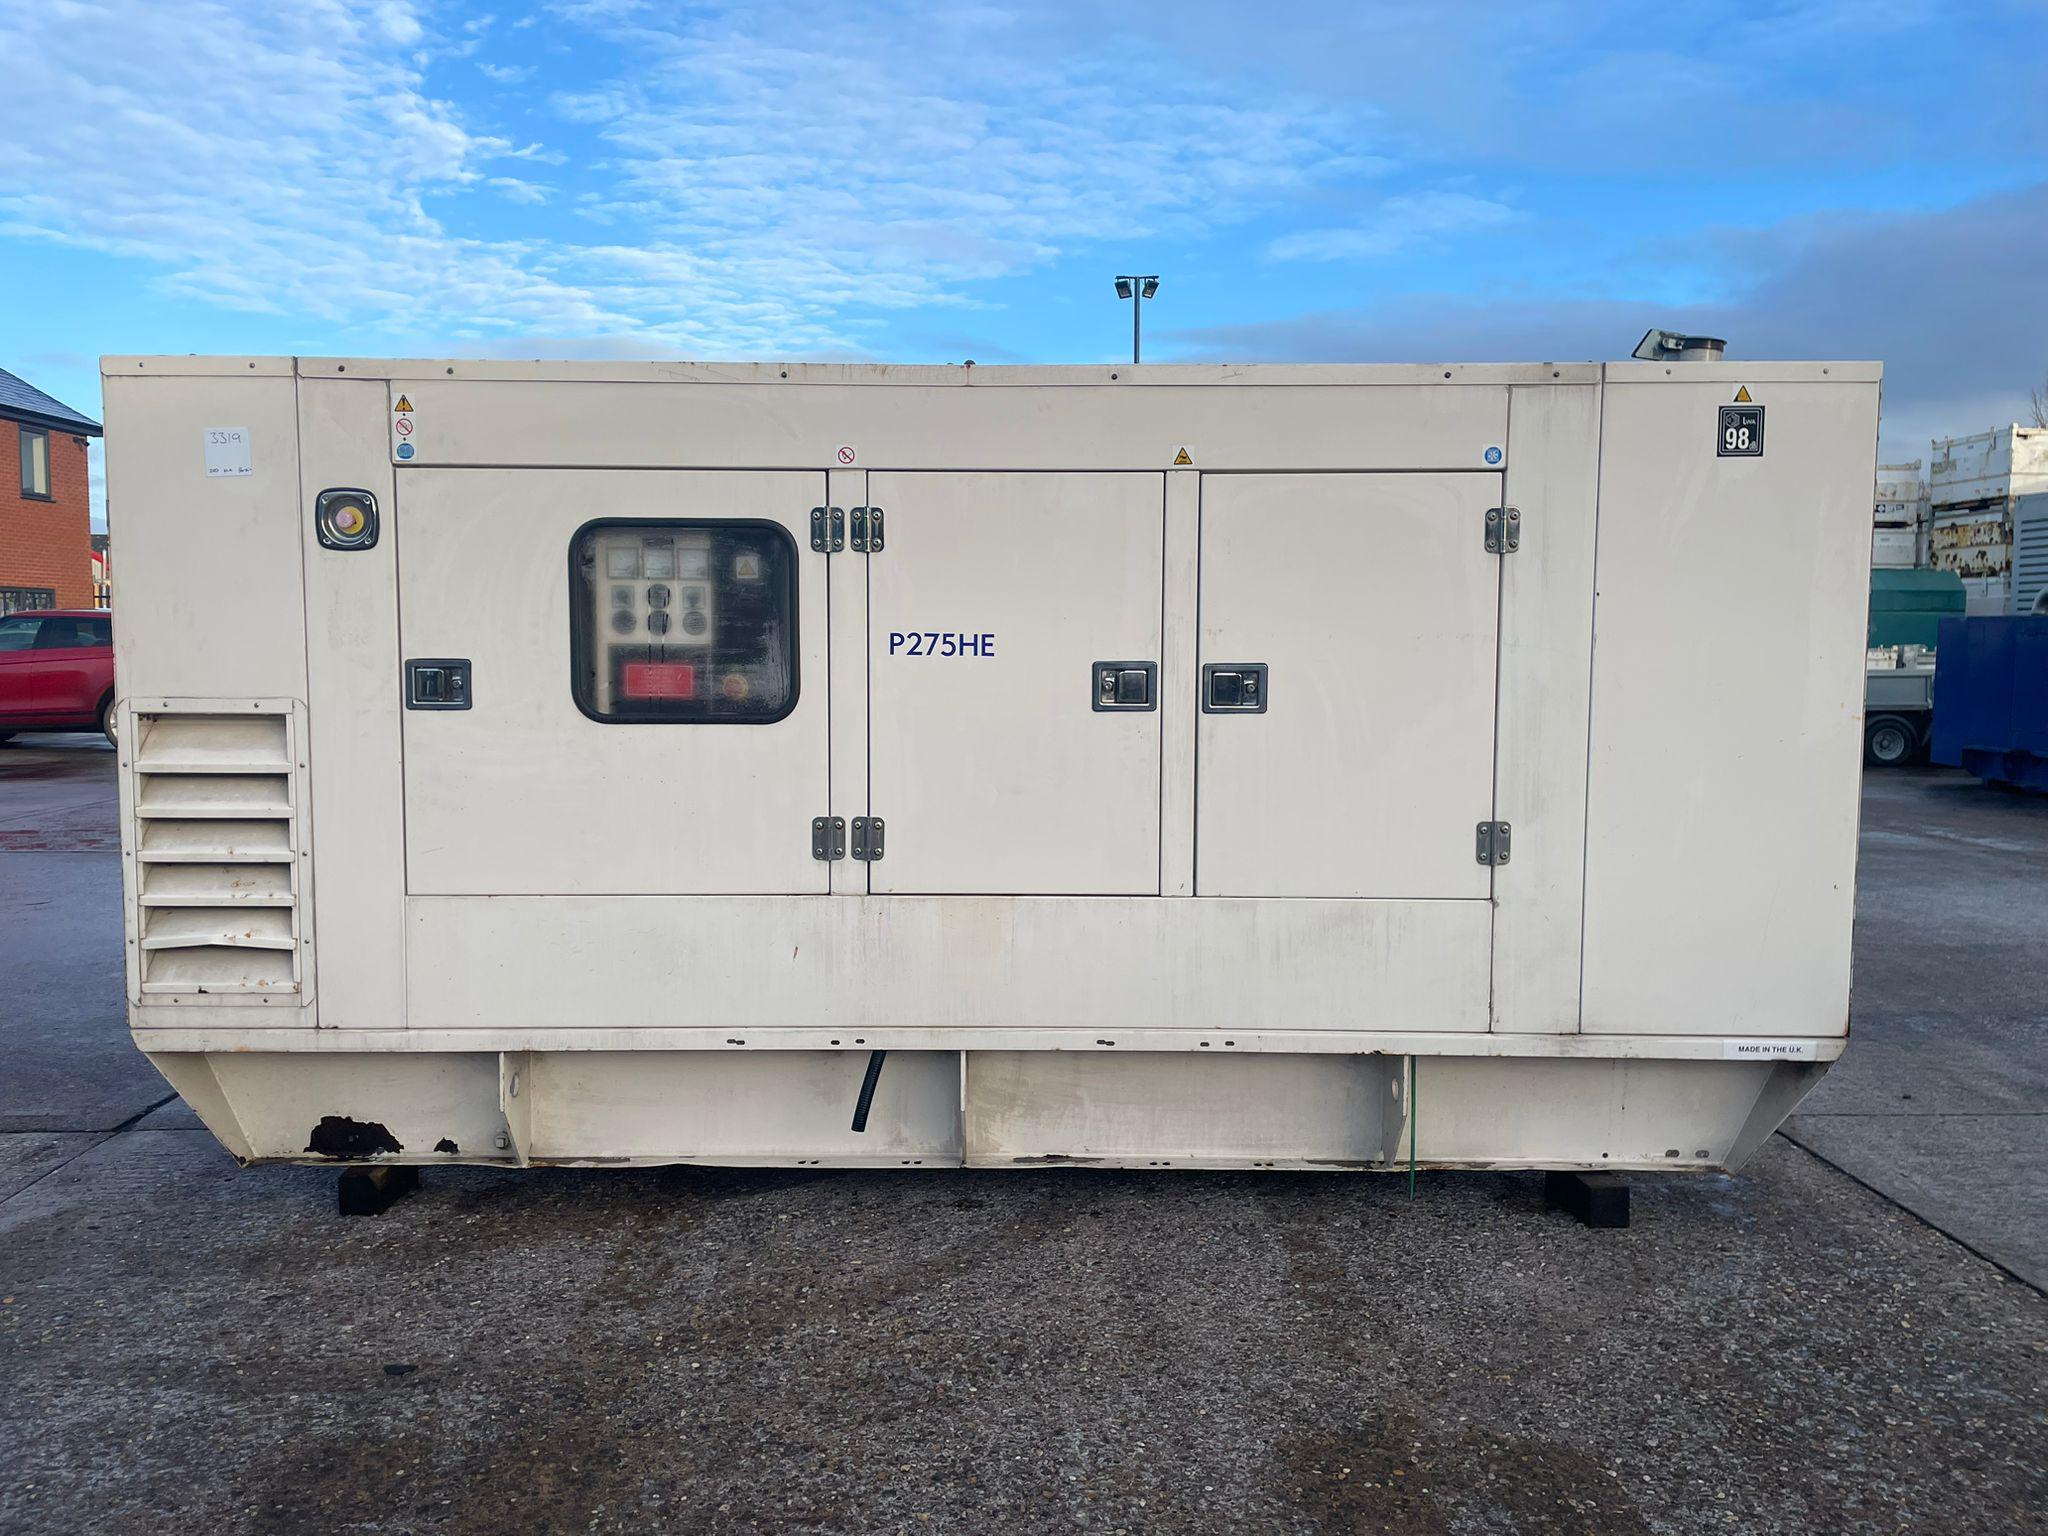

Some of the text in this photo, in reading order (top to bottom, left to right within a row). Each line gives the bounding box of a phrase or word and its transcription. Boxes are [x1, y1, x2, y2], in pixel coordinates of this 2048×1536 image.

[209, 431, 242, 444] 3319
[1725, 427, 1749, 449] 98
[889, 632, 995, 657] P275HE
